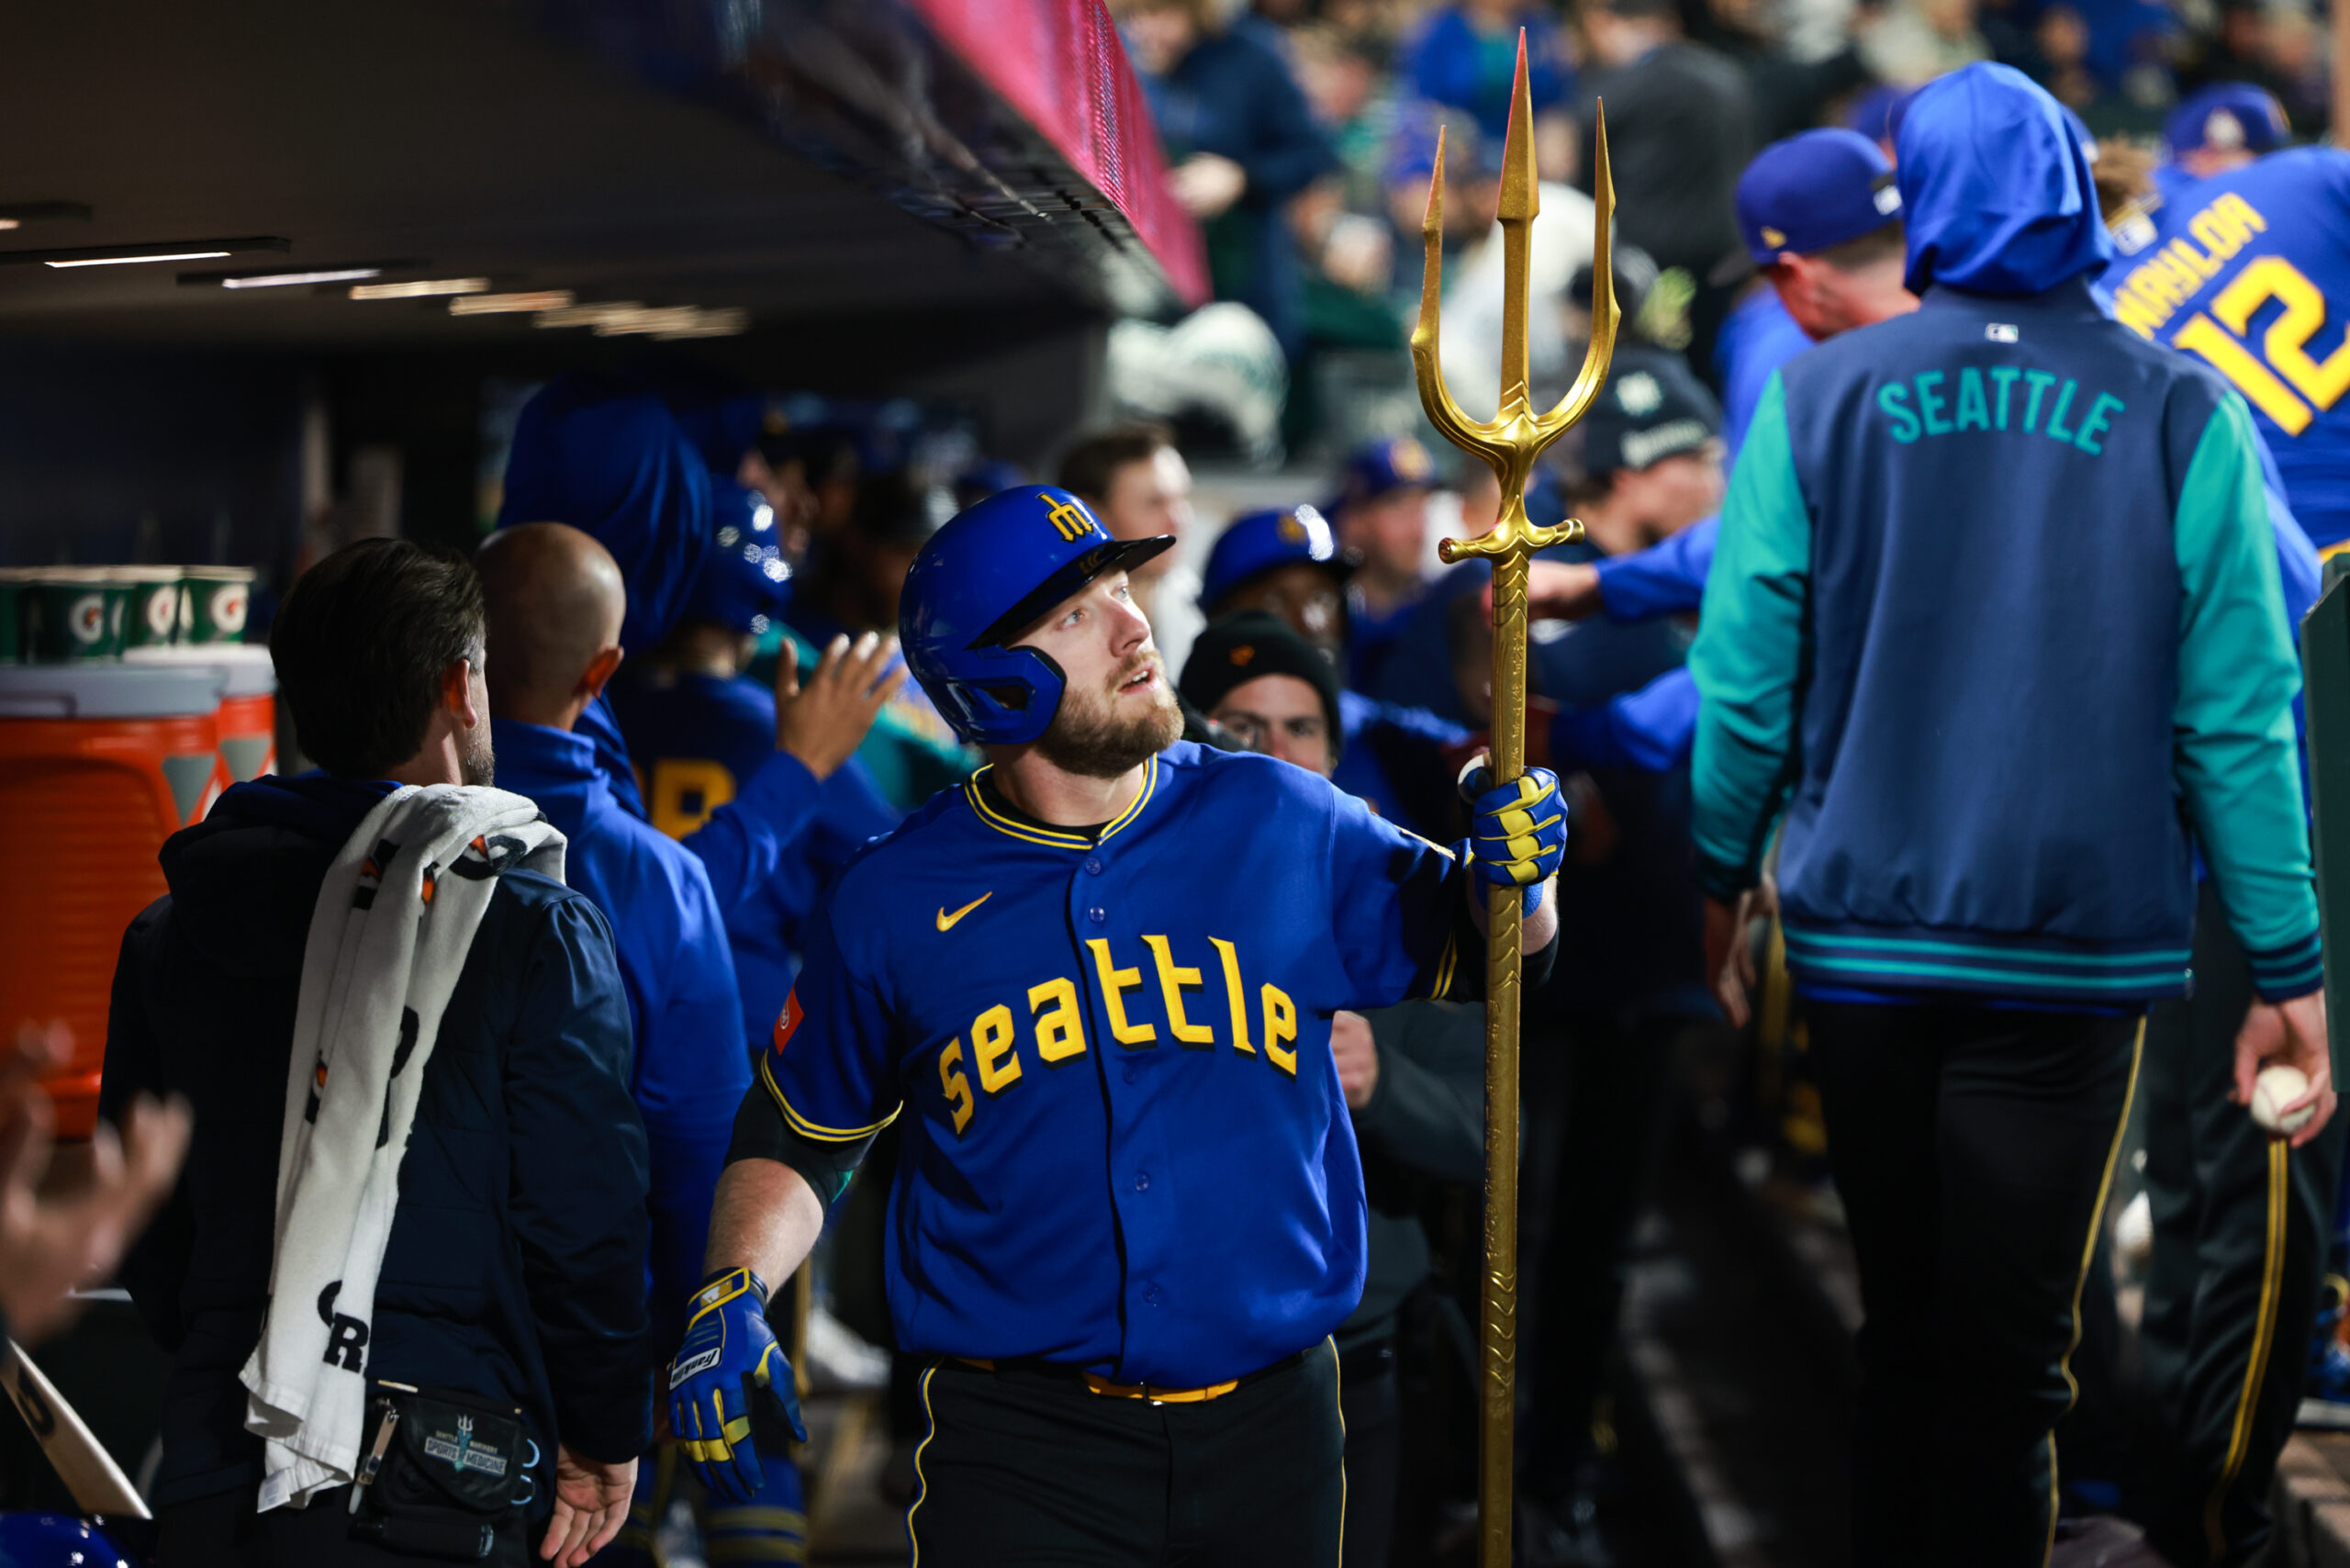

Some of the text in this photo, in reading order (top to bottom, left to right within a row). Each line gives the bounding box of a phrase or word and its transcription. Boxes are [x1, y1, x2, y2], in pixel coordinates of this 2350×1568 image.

[1877, 365, 2126, 456] SEATTLE
[2172, 254, 2350, 438] 12
[939, 935, 1298, 1142] seattle
[427, 1439, 505, 1473] SPORTS MEDICINE
